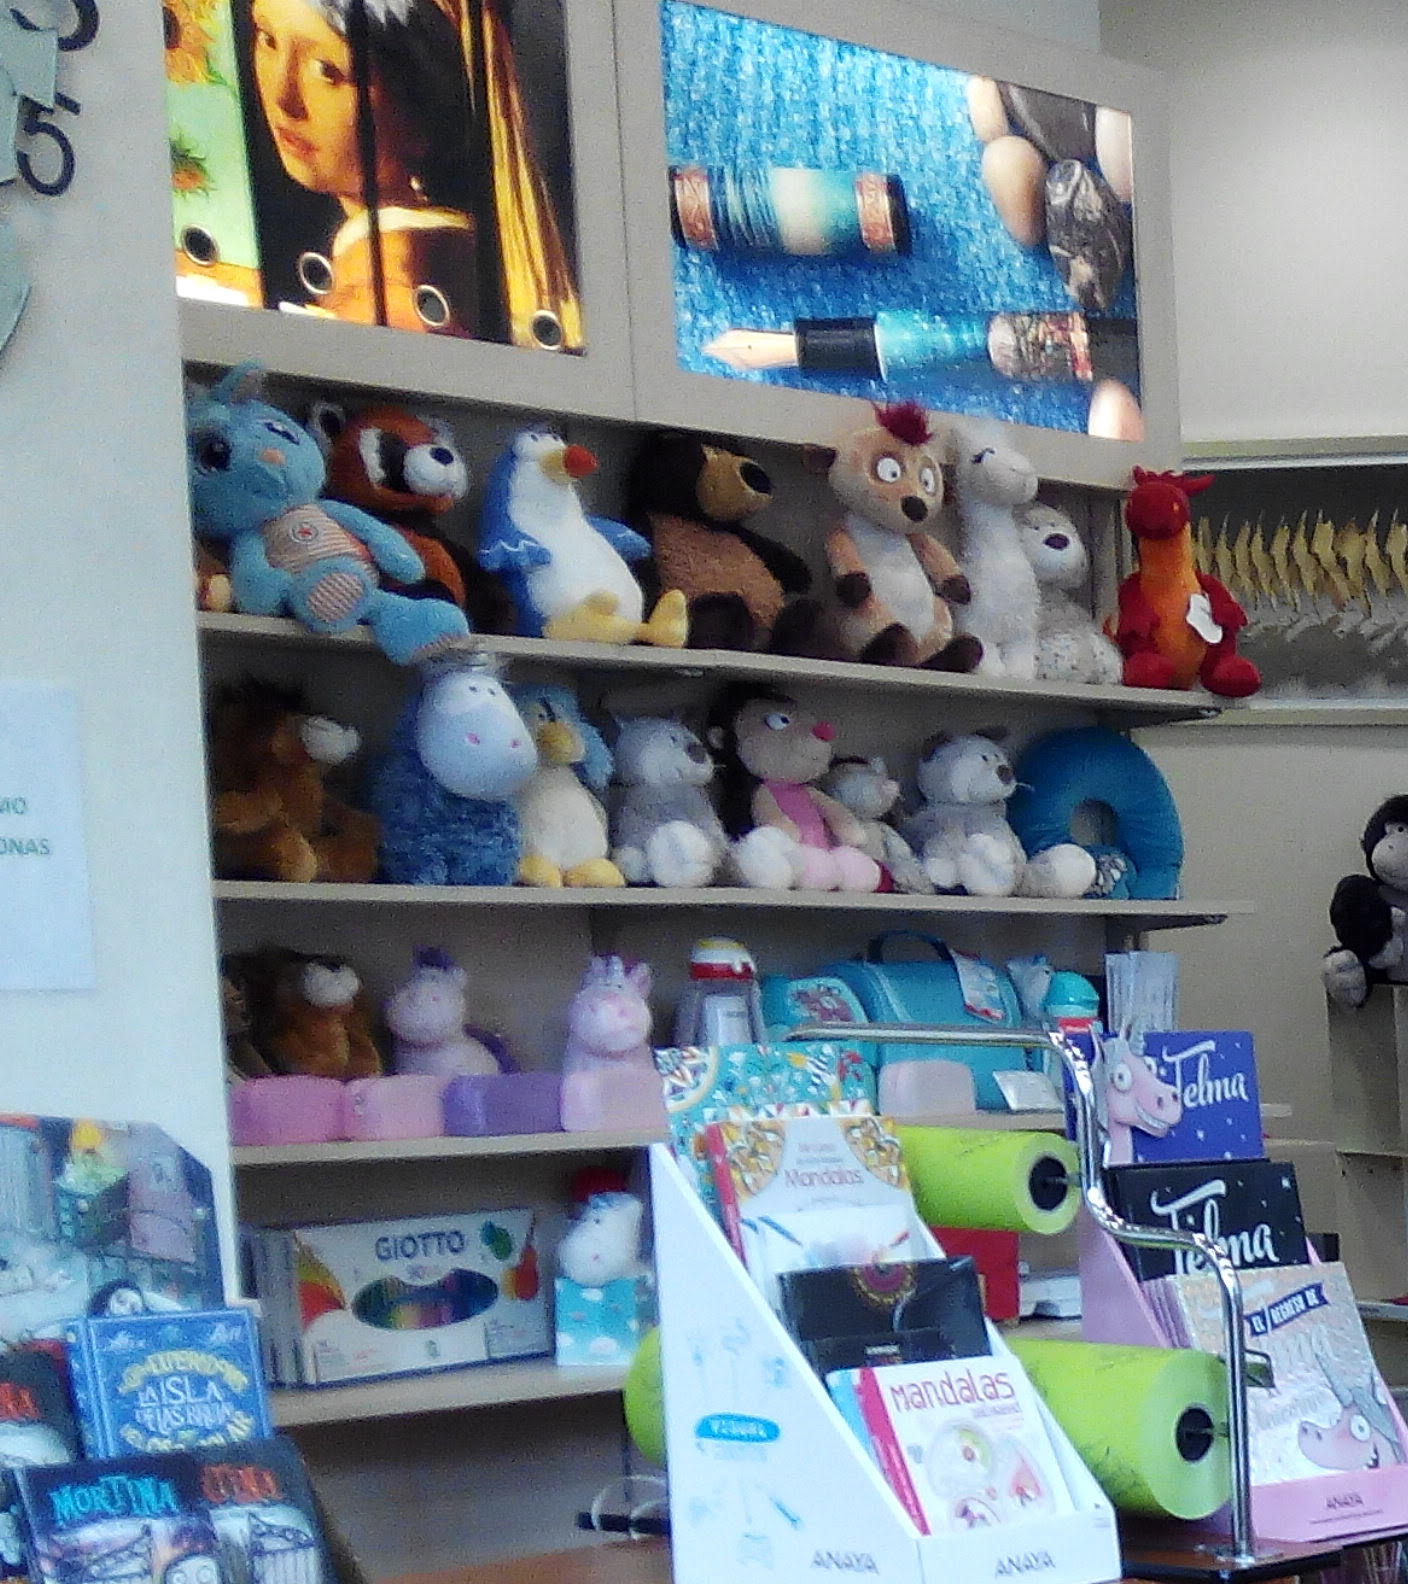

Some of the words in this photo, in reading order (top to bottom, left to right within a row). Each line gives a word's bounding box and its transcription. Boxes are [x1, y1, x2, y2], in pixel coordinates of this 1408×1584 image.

[1161, 1042, 1249, 1111] Telma
[374, 1229, 466, 1262] GIOTTO
[810, 1550, 879, 1575] ANAYA
[994, 1550, 1056, 1578] ANAYA
